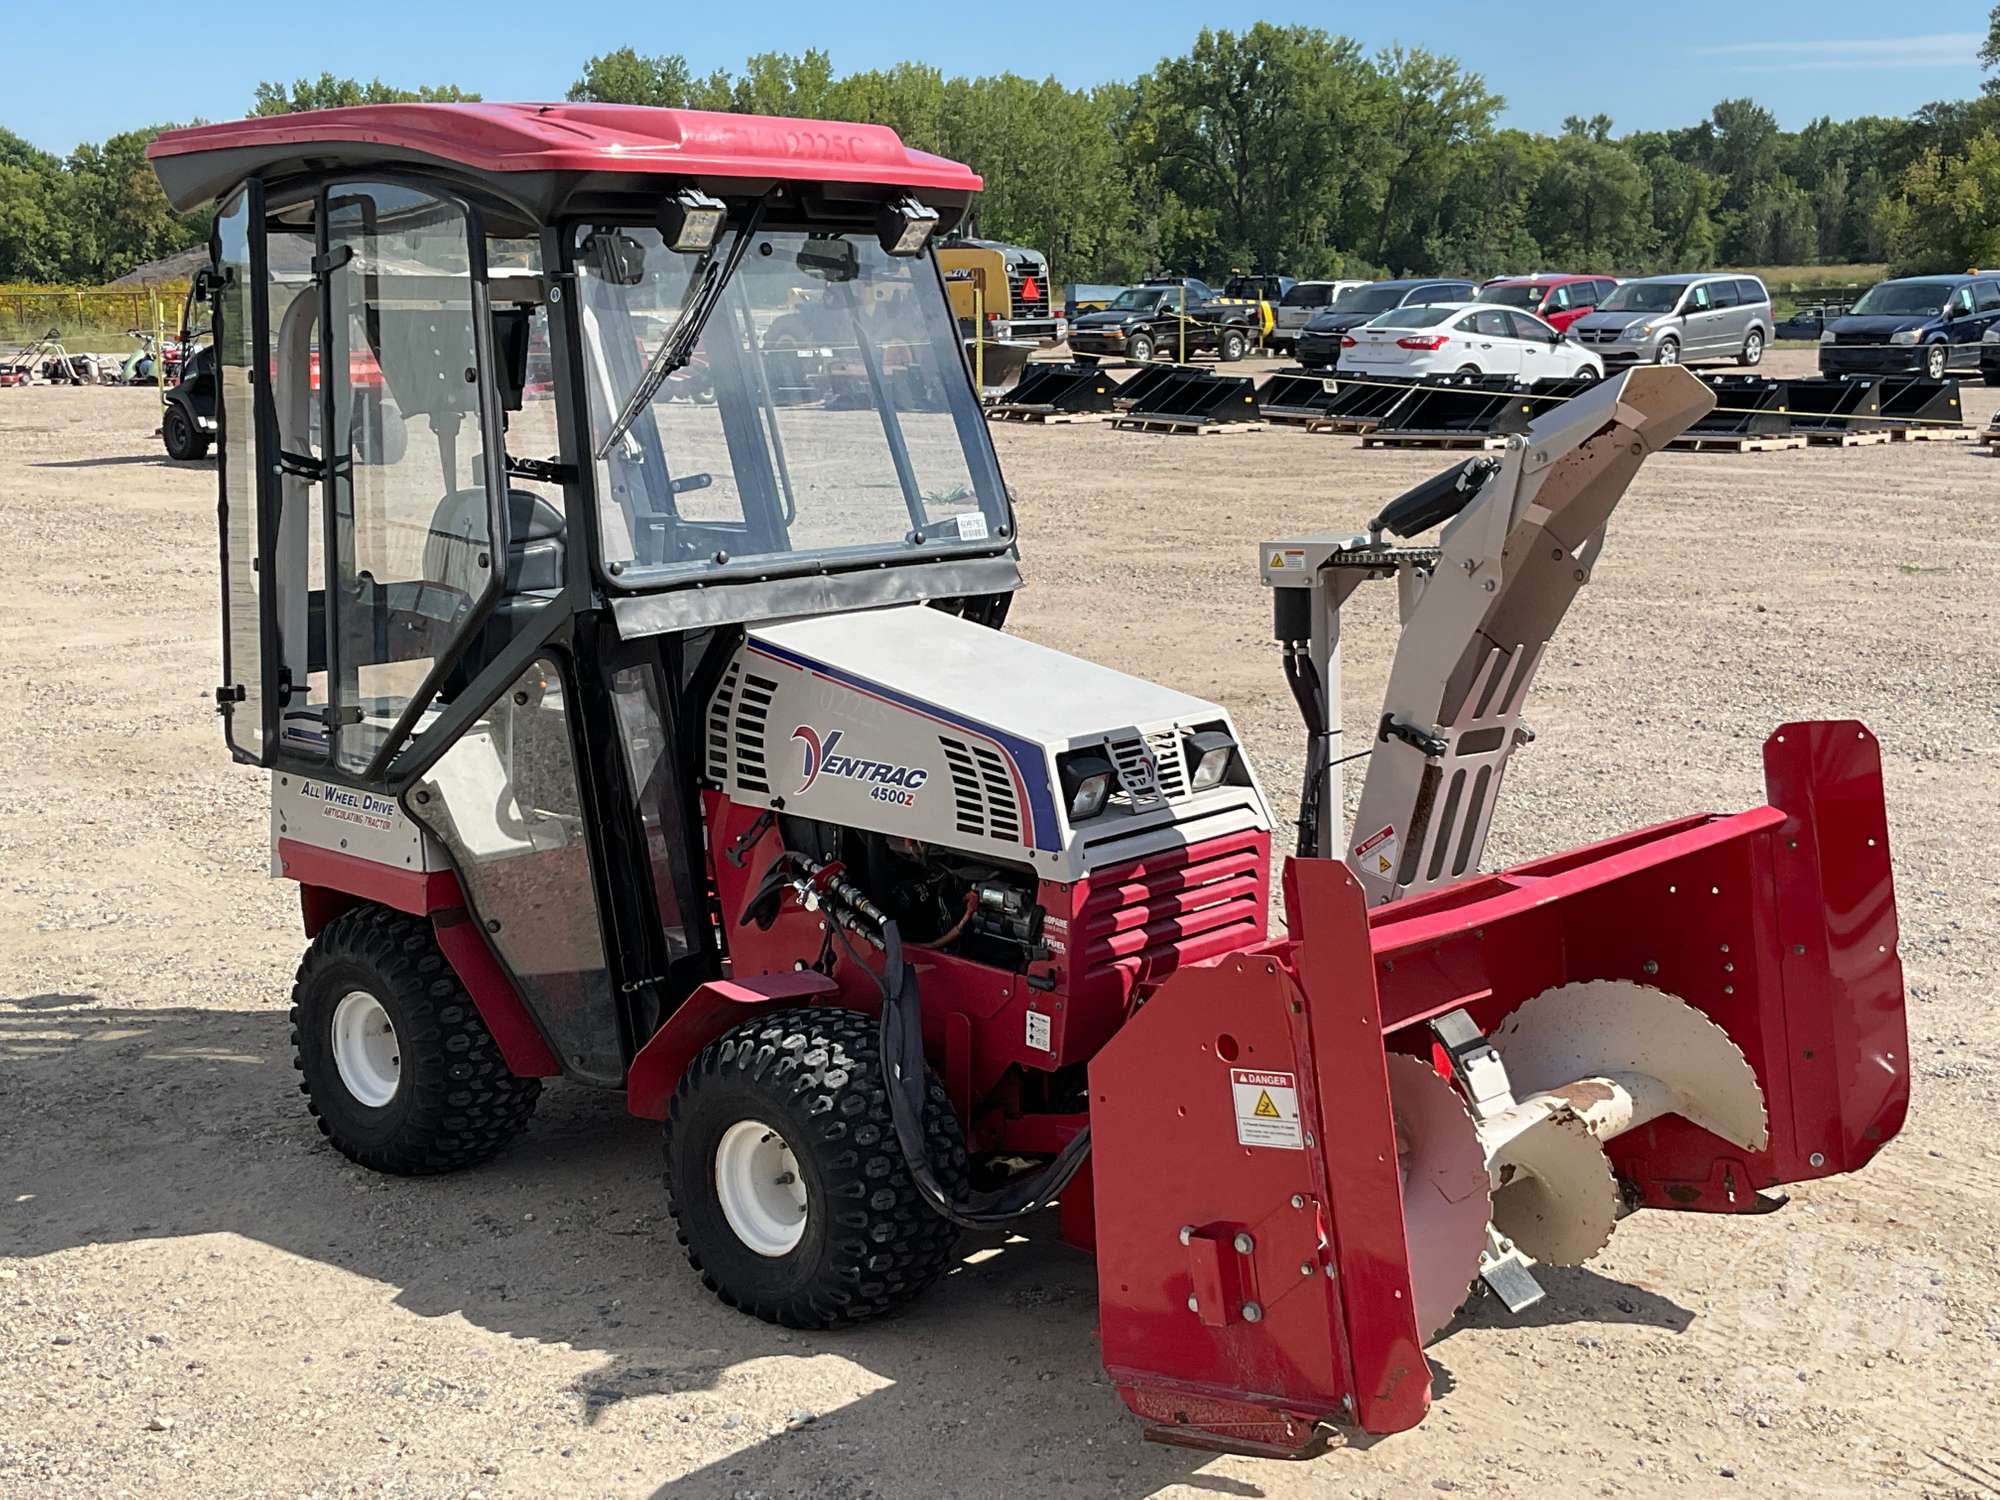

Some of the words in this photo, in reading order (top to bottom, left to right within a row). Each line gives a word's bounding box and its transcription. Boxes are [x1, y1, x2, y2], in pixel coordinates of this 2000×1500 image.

[791, 726, 928, 794] VENTRAC
[324, 806, 364, 824] ARTICULATING
[366, 815, 392, 830] TRACTOR
[1047, 939, 1065, 950] FUEL
[1248, 1074, 1287, 1086] DANGER
